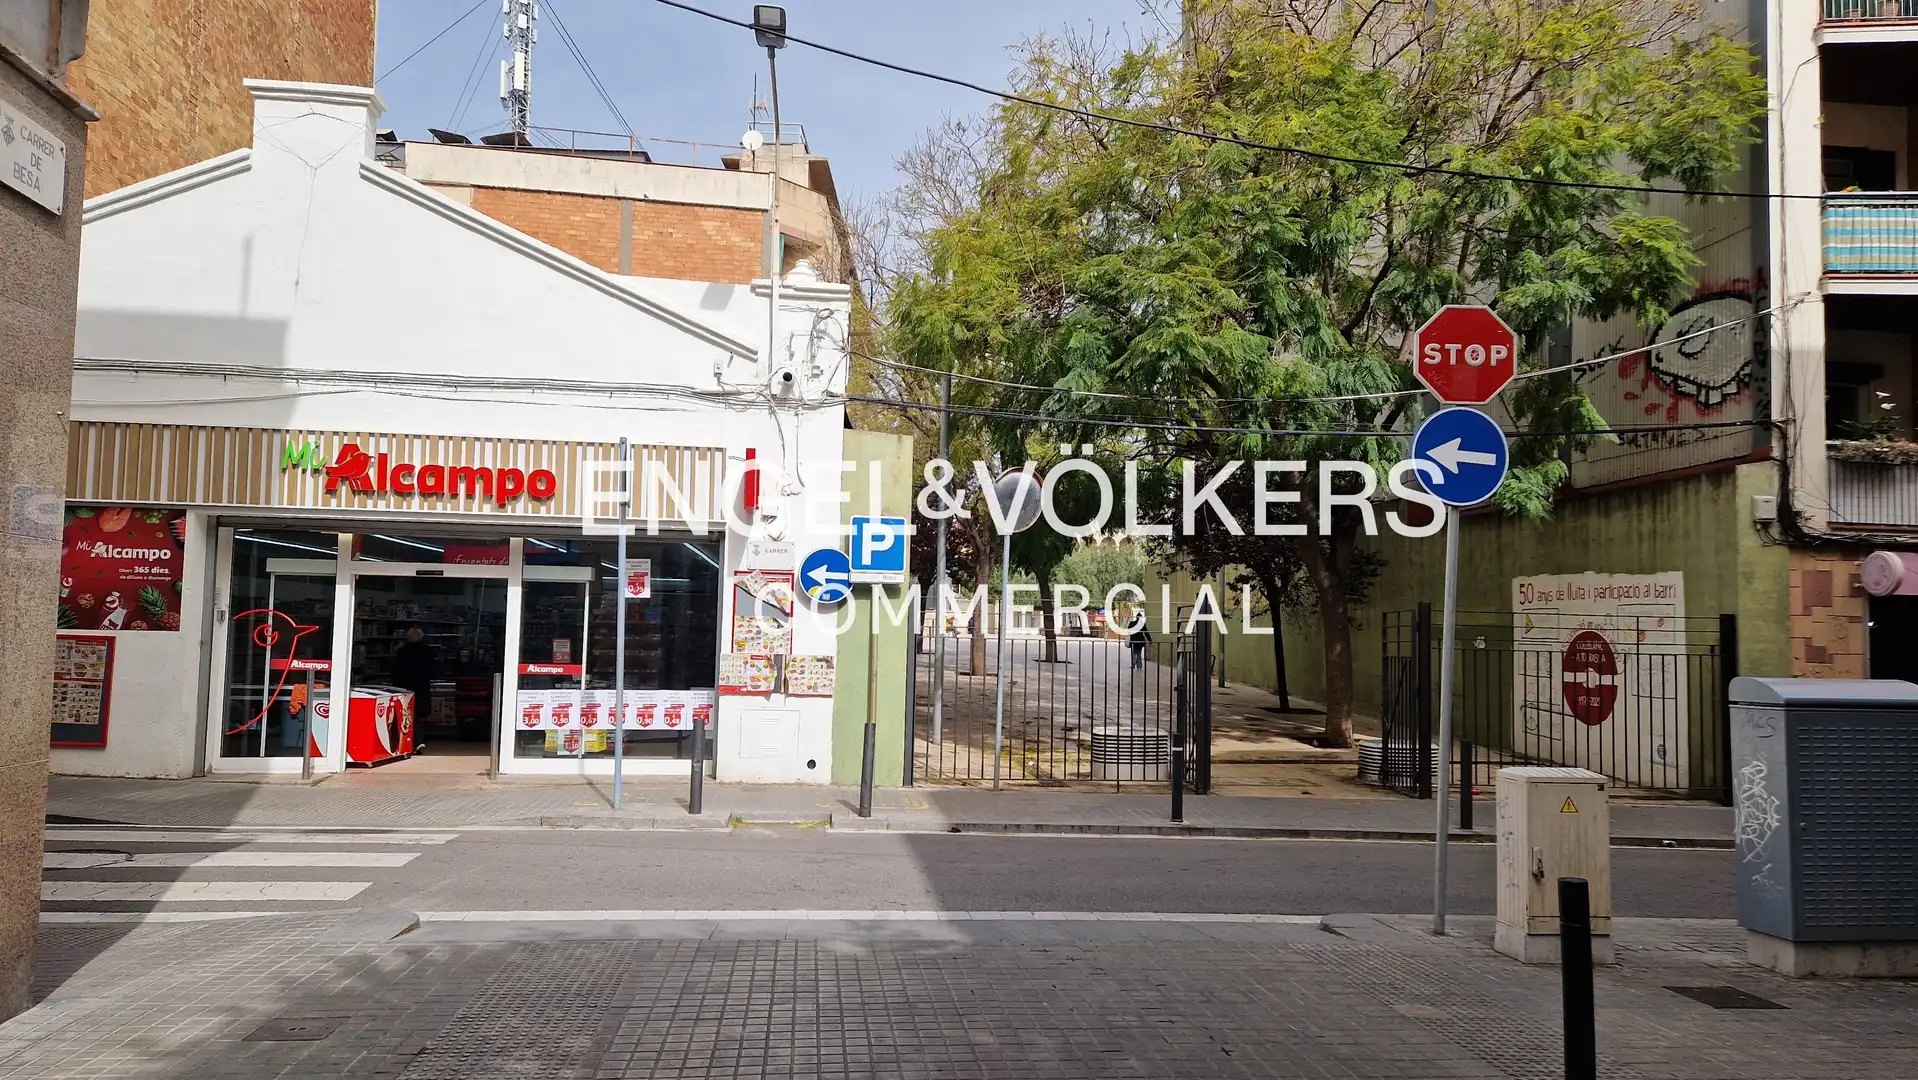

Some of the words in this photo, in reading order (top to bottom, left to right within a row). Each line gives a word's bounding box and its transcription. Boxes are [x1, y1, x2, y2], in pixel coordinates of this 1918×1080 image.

[20, 125, 55, 160] CARRER
[30, 152, 42, 172] DE
[13, 161, 41, 194] BESA
[1423, 342, 1508, 367] STOP
[281, 439, 327, 473] Mi
[324, 443, 557, 505] Alcampo
[76, 540, 92, 551] Mi
[90, 541, 172, 561] Alcampo
[861, 522, 895, 566] P
[133, 565, 150, 574] 365
[1519, 582, 1534, 605] 50
[1536, 590, 1554, 606] anys
[1555, 585, 1565, 601] de
[1567, 582, 1586, 601] lluita
[1593, 583, 1641, 603] participació
[1643, 583, 1651, 598] al
[1654, 583, 1677, 600] barri
[290, 659, 329, 670] Alcampo
[526, 664, 564, 675] Alcampo
